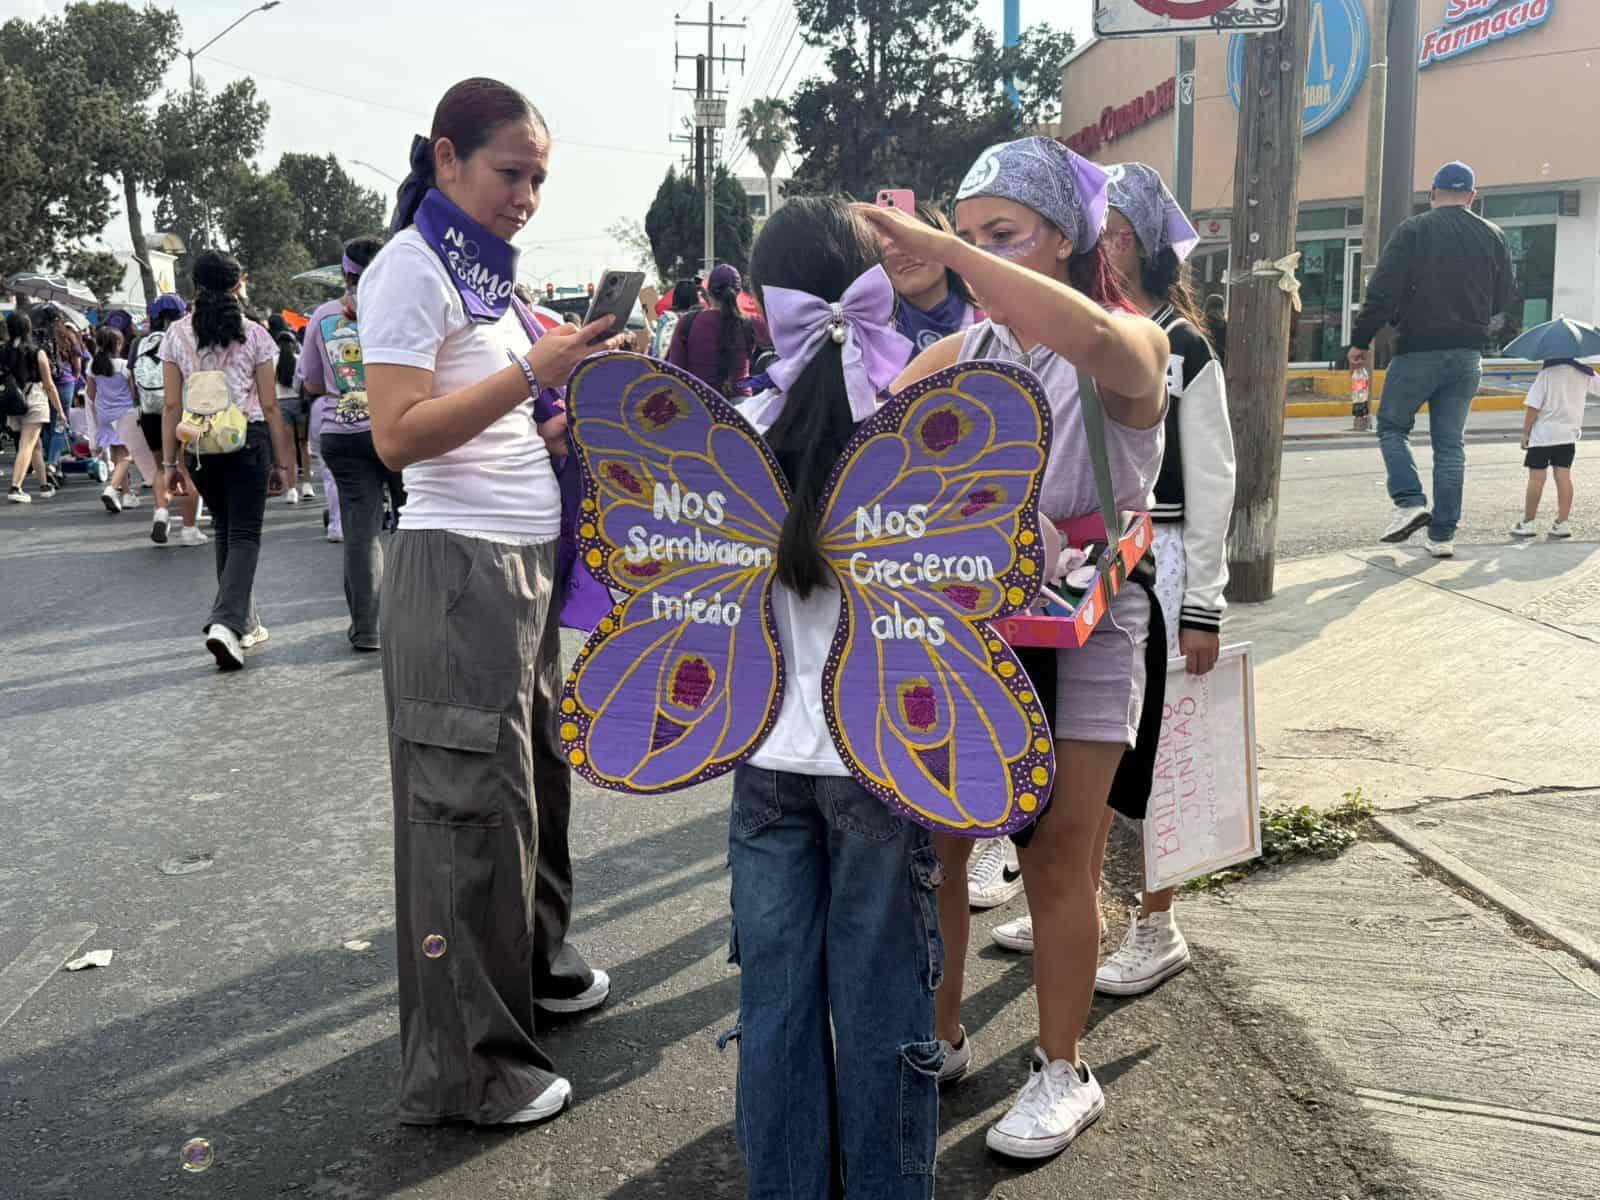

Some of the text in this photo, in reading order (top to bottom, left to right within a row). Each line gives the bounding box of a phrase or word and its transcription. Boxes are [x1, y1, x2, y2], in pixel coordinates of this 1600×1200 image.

[1420, 0, 1547, 62] Farmacia
[625, 525, 772, 568] Sembraron
[850, 552, 994, 588] Crecieron
[652, 591, 741, 625] miedo
[871, 600, 946, 646] alas
[1174, 696, 1199, 827] JUNTAS
